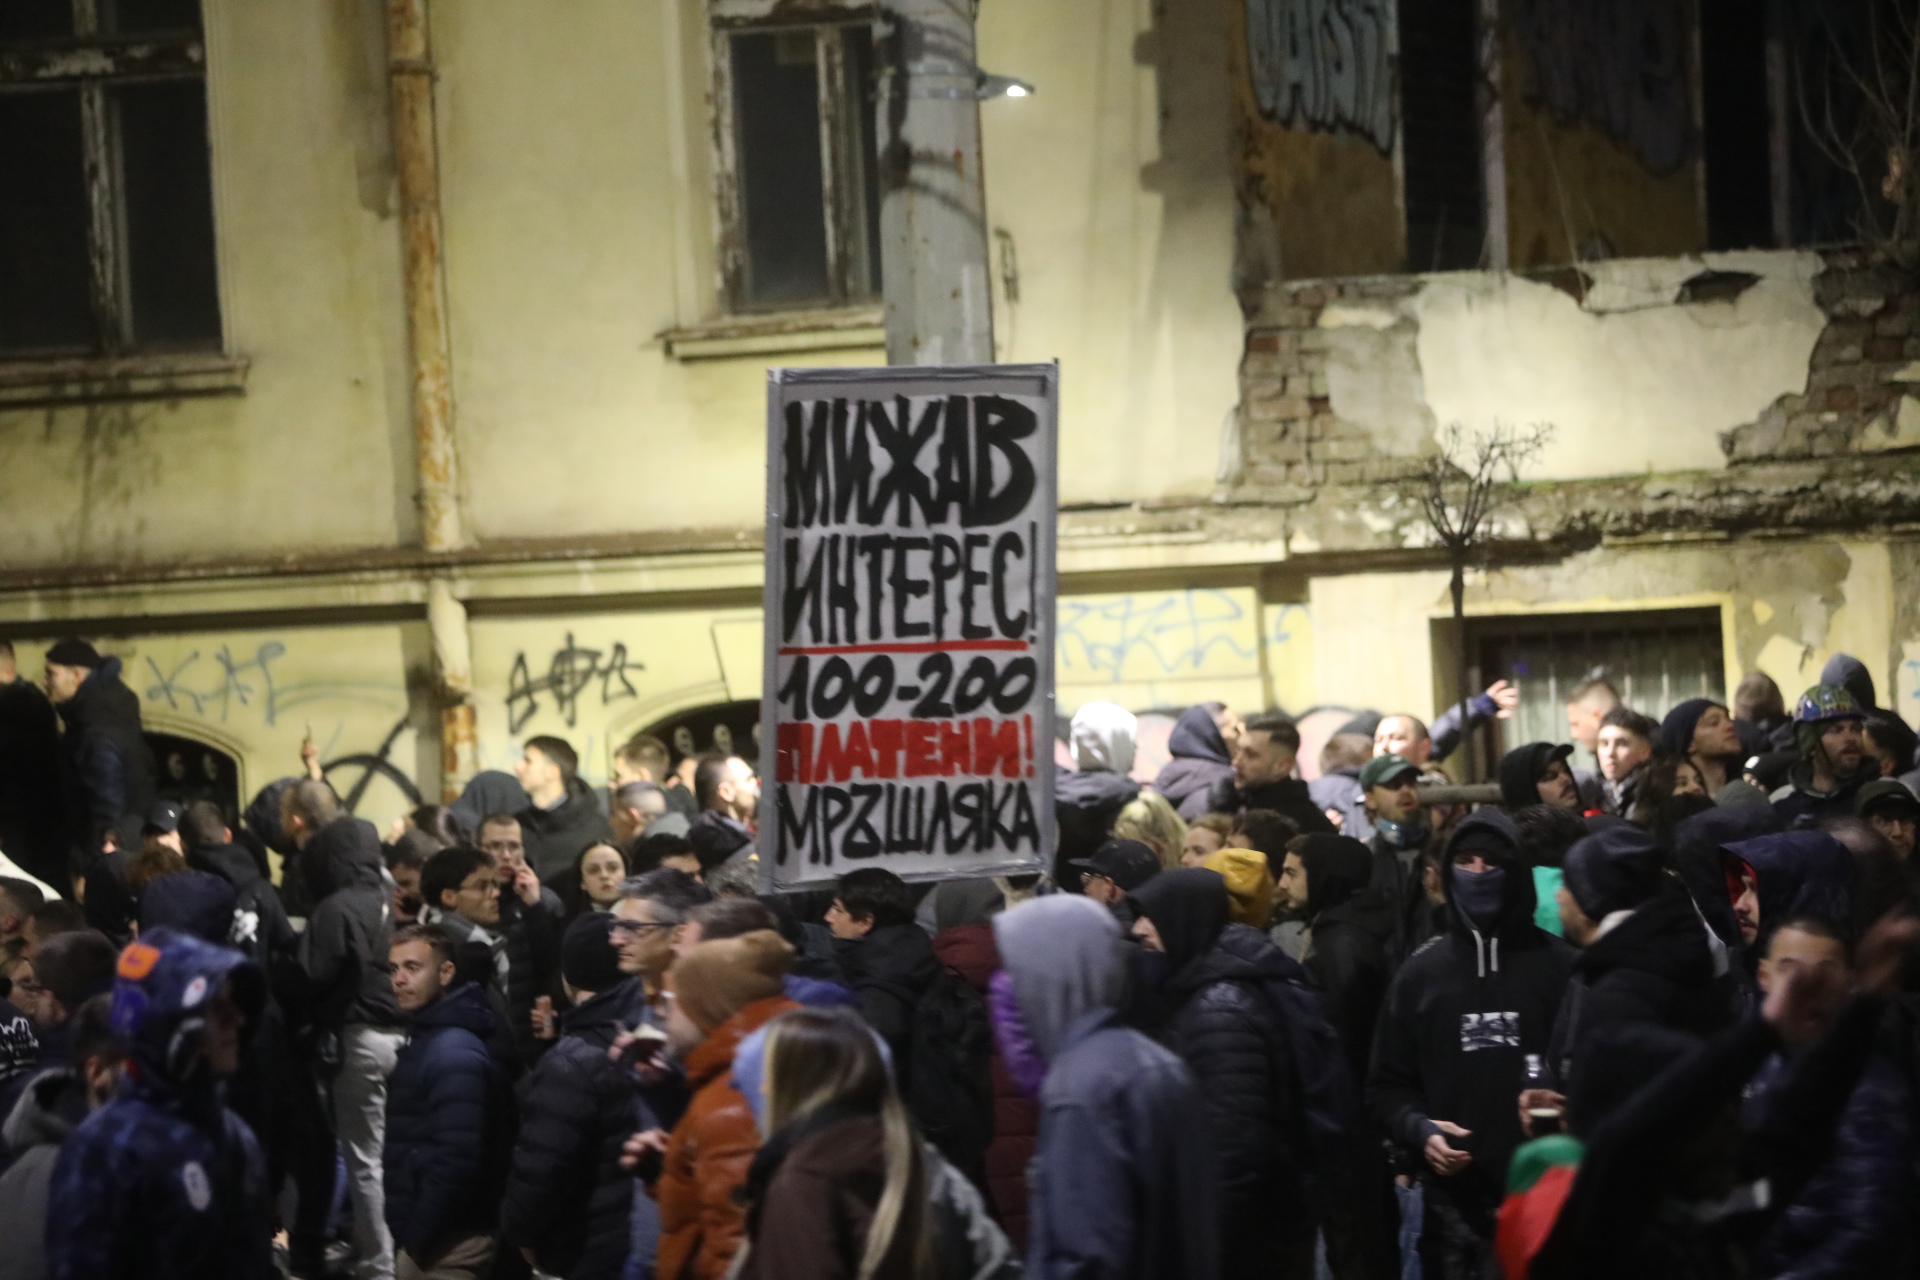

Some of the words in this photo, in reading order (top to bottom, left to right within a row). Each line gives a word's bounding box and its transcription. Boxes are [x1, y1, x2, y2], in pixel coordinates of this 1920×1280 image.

[784, 394, 1037, 529] МИЖАВ
[783, 522, 1037, 645] ИНТЕРЕС!
[778, 652, 1037, 721] 100-200
[776, 713, 1035, 784] ПЛАТЕНИ!
[775, 780, 1040, 867] МРЪШЛЯКА
